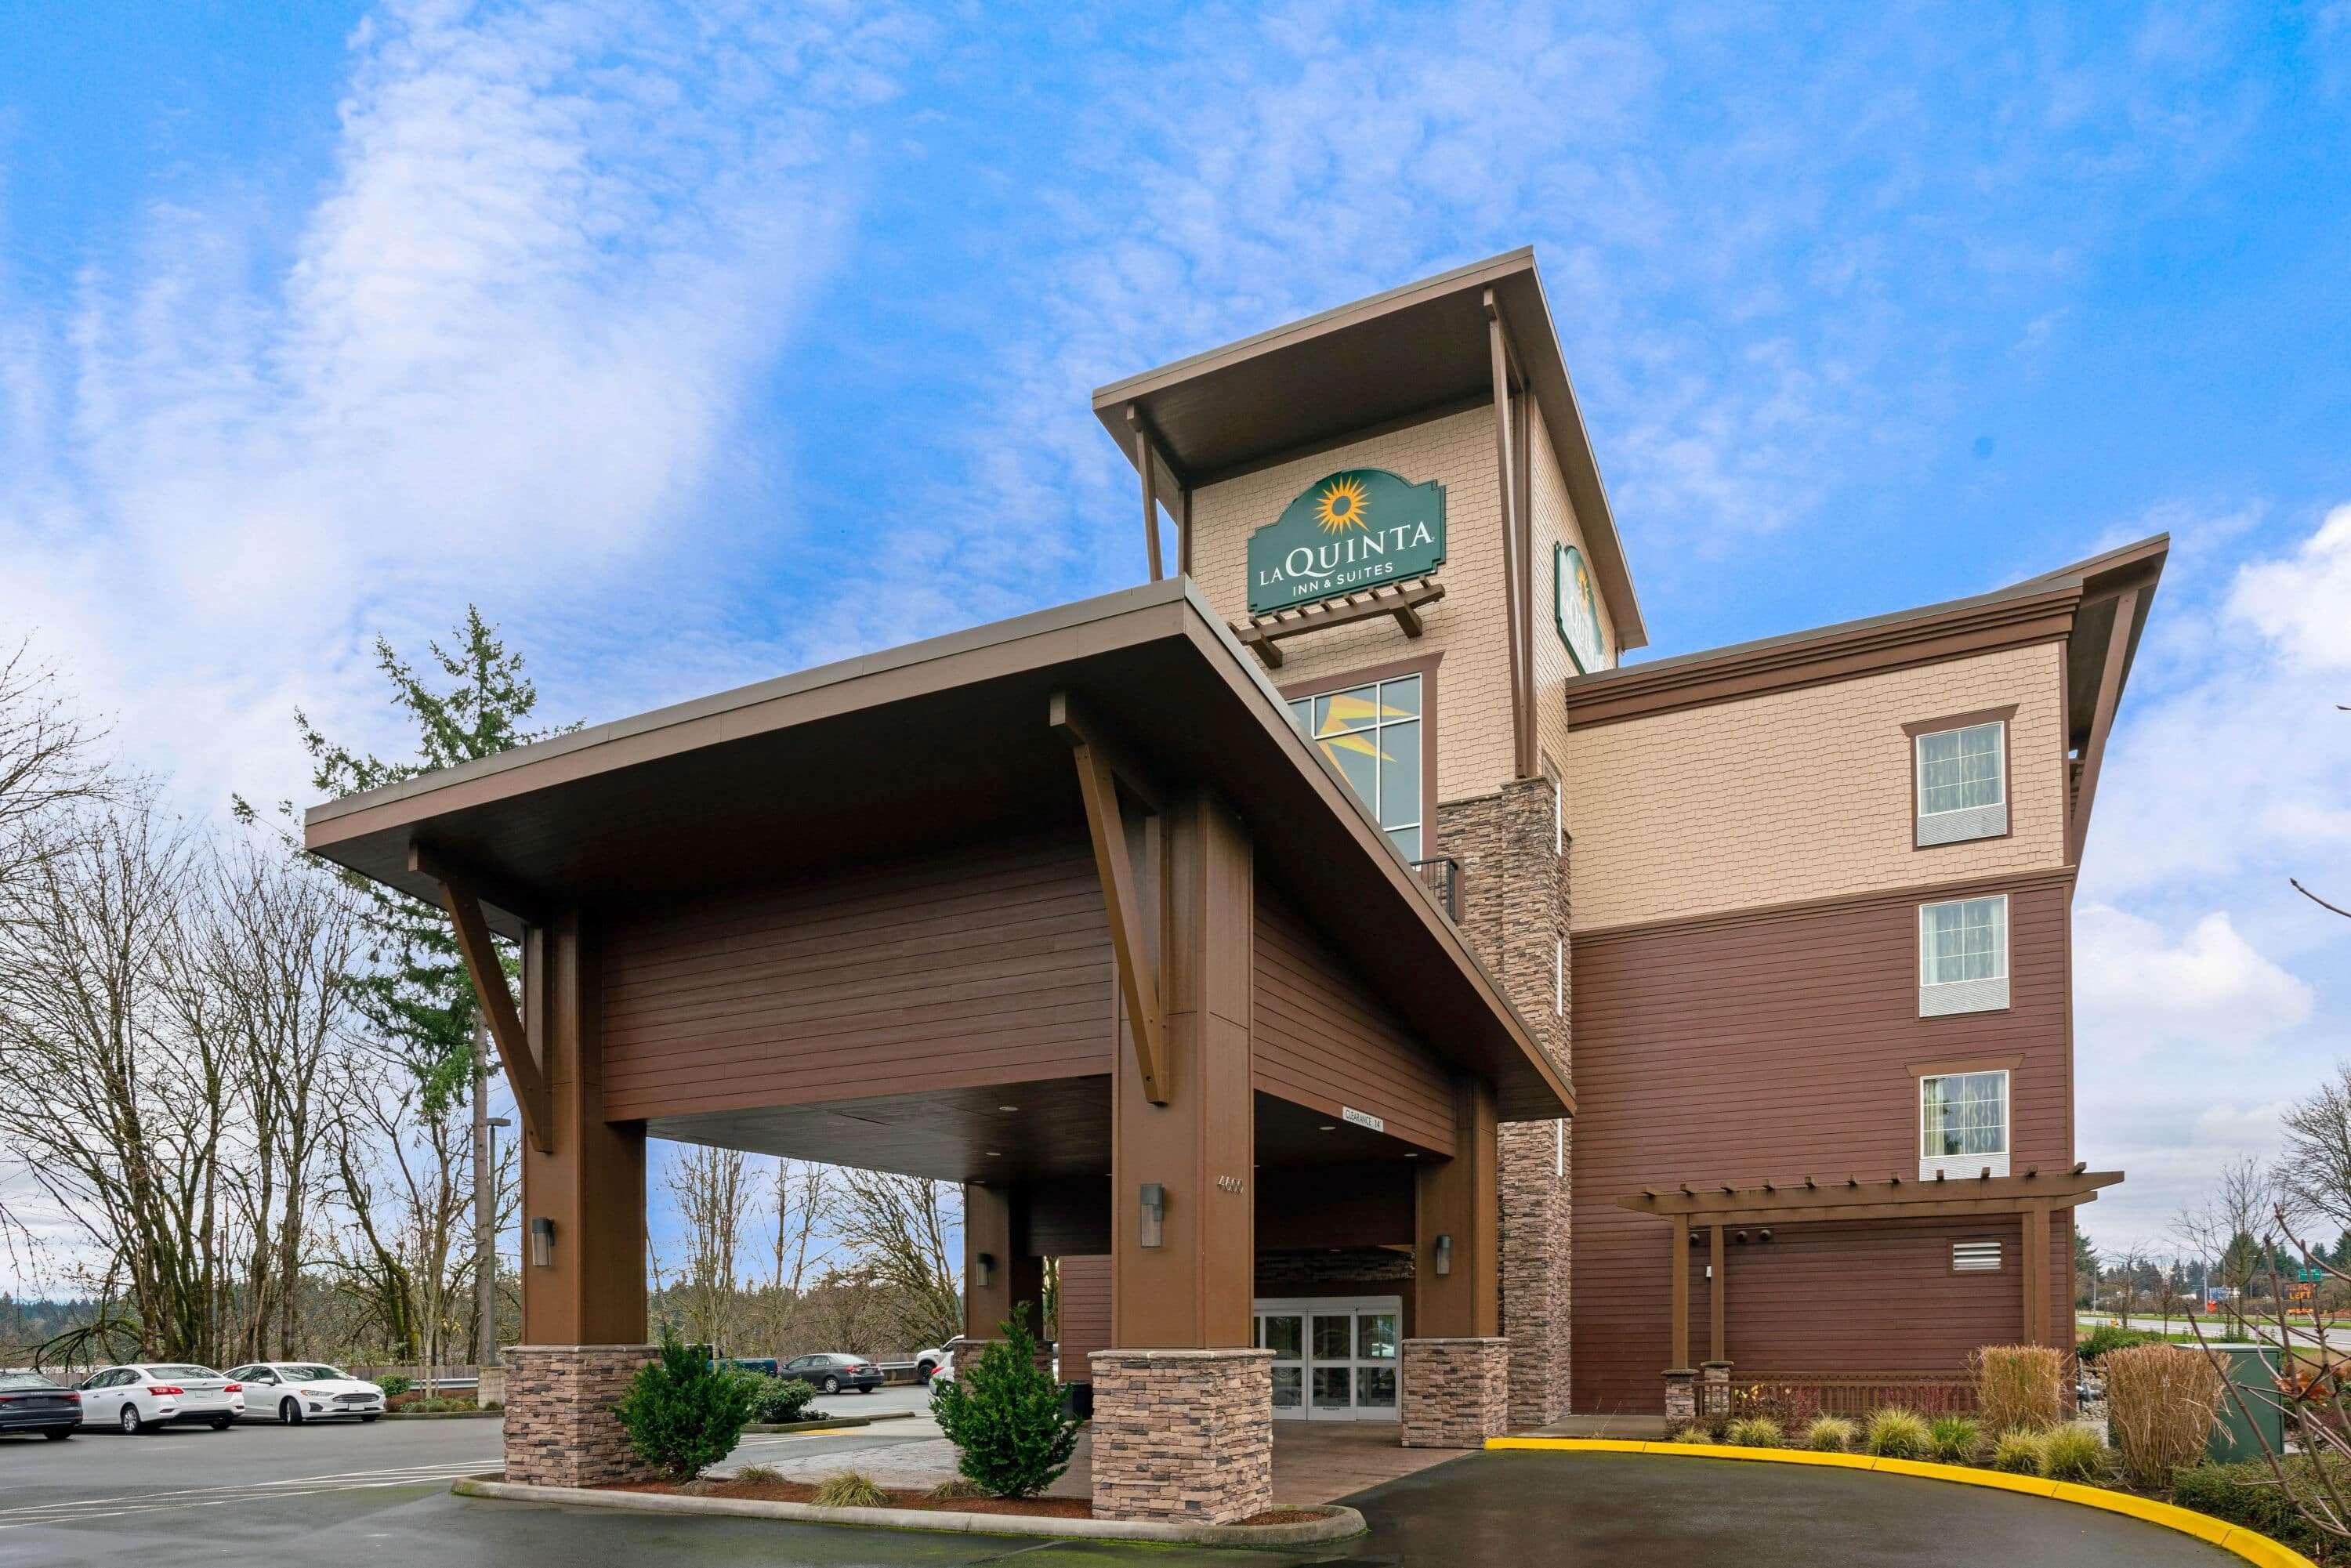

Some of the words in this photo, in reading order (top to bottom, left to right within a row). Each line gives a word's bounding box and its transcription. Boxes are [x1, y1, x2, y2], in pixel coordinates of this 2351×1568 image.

[1259, 567, 1284, 586] LA
[1285, 521, 1433, 578] QUINTA
[1293, 581, 1318, 596] INN
[1324, 579, 1331, 588] &
[1337, 562, 1393, 585] SUITES
[1218, 1175, 1243, 1193] 4600
